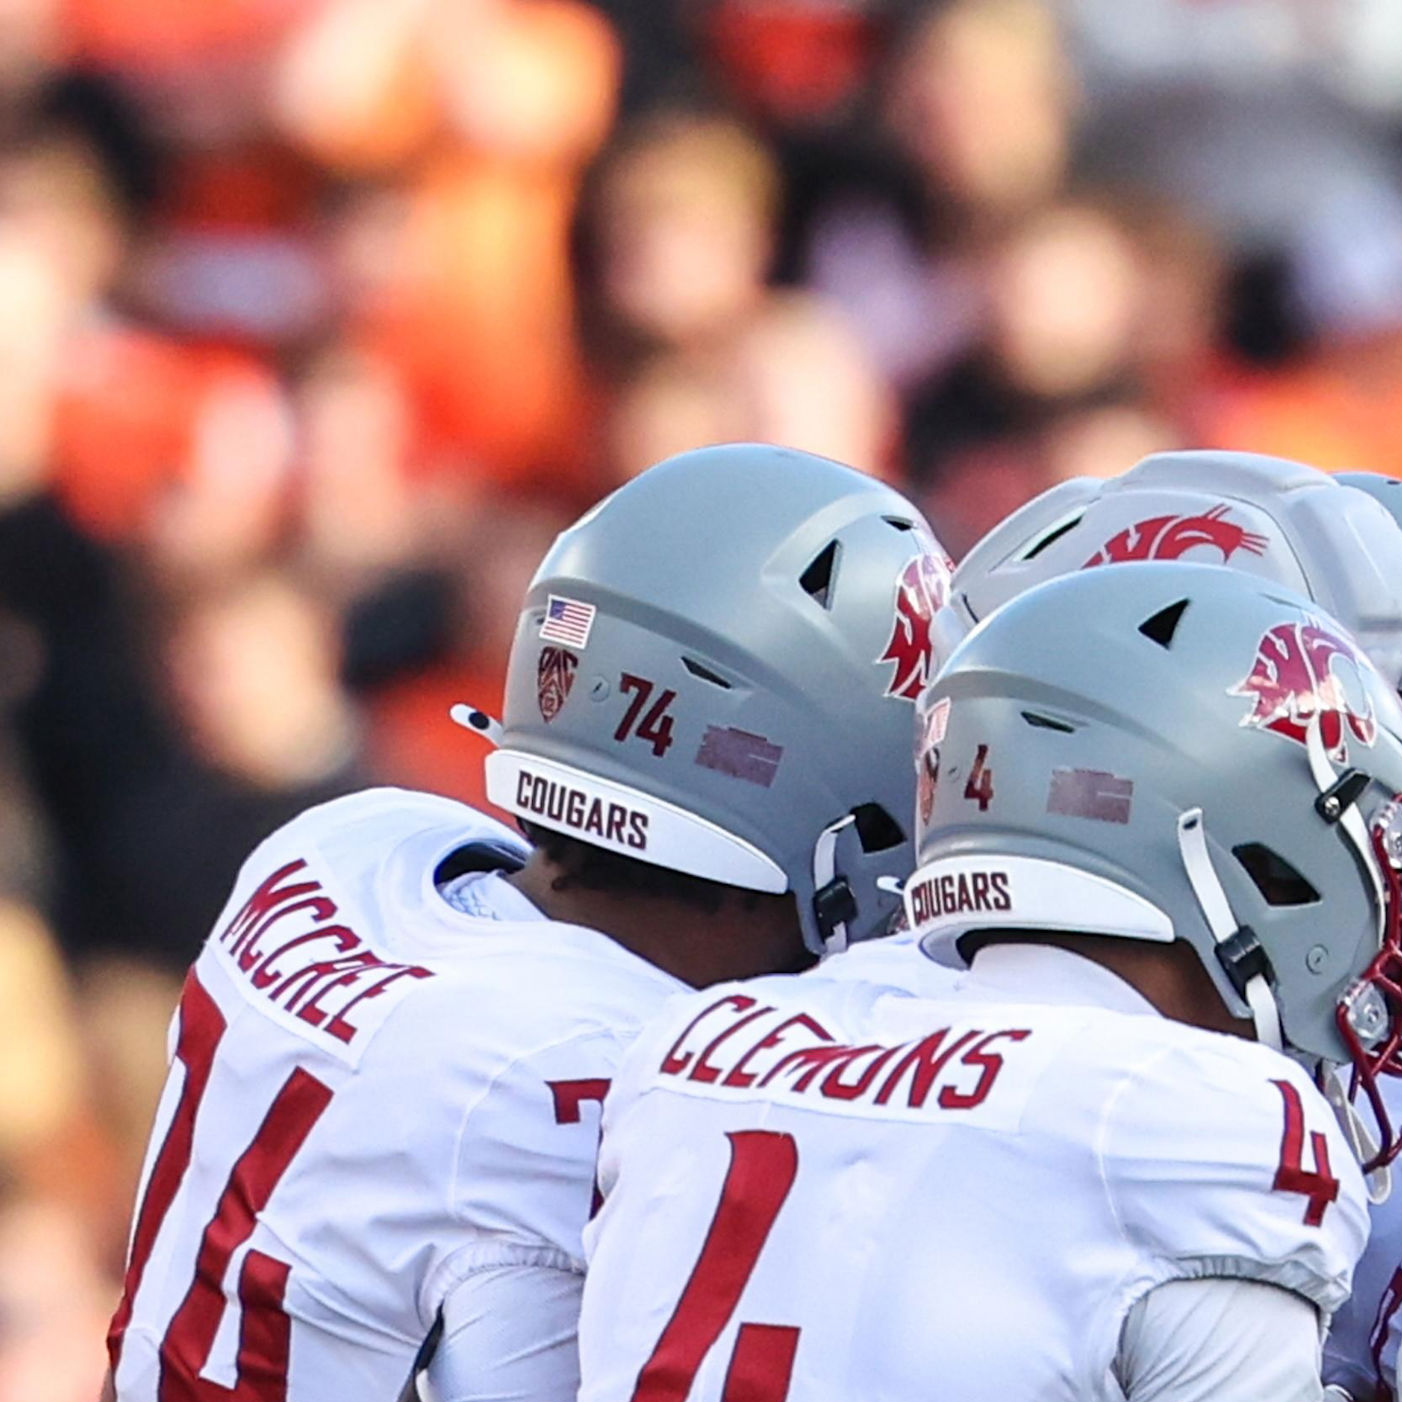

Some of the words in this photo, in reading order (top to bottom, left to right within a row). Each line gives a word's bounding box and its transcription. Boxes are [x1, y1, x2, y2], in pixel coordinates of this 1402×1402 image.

[613, 672, 677, 758] 74
[516, 770, 649, 850] COUGARS
[964, 744, 994, 812] 4
[660, 994, 1032, 1110] CLEMONS
[1269, 1079, 1339, 1228] 4
